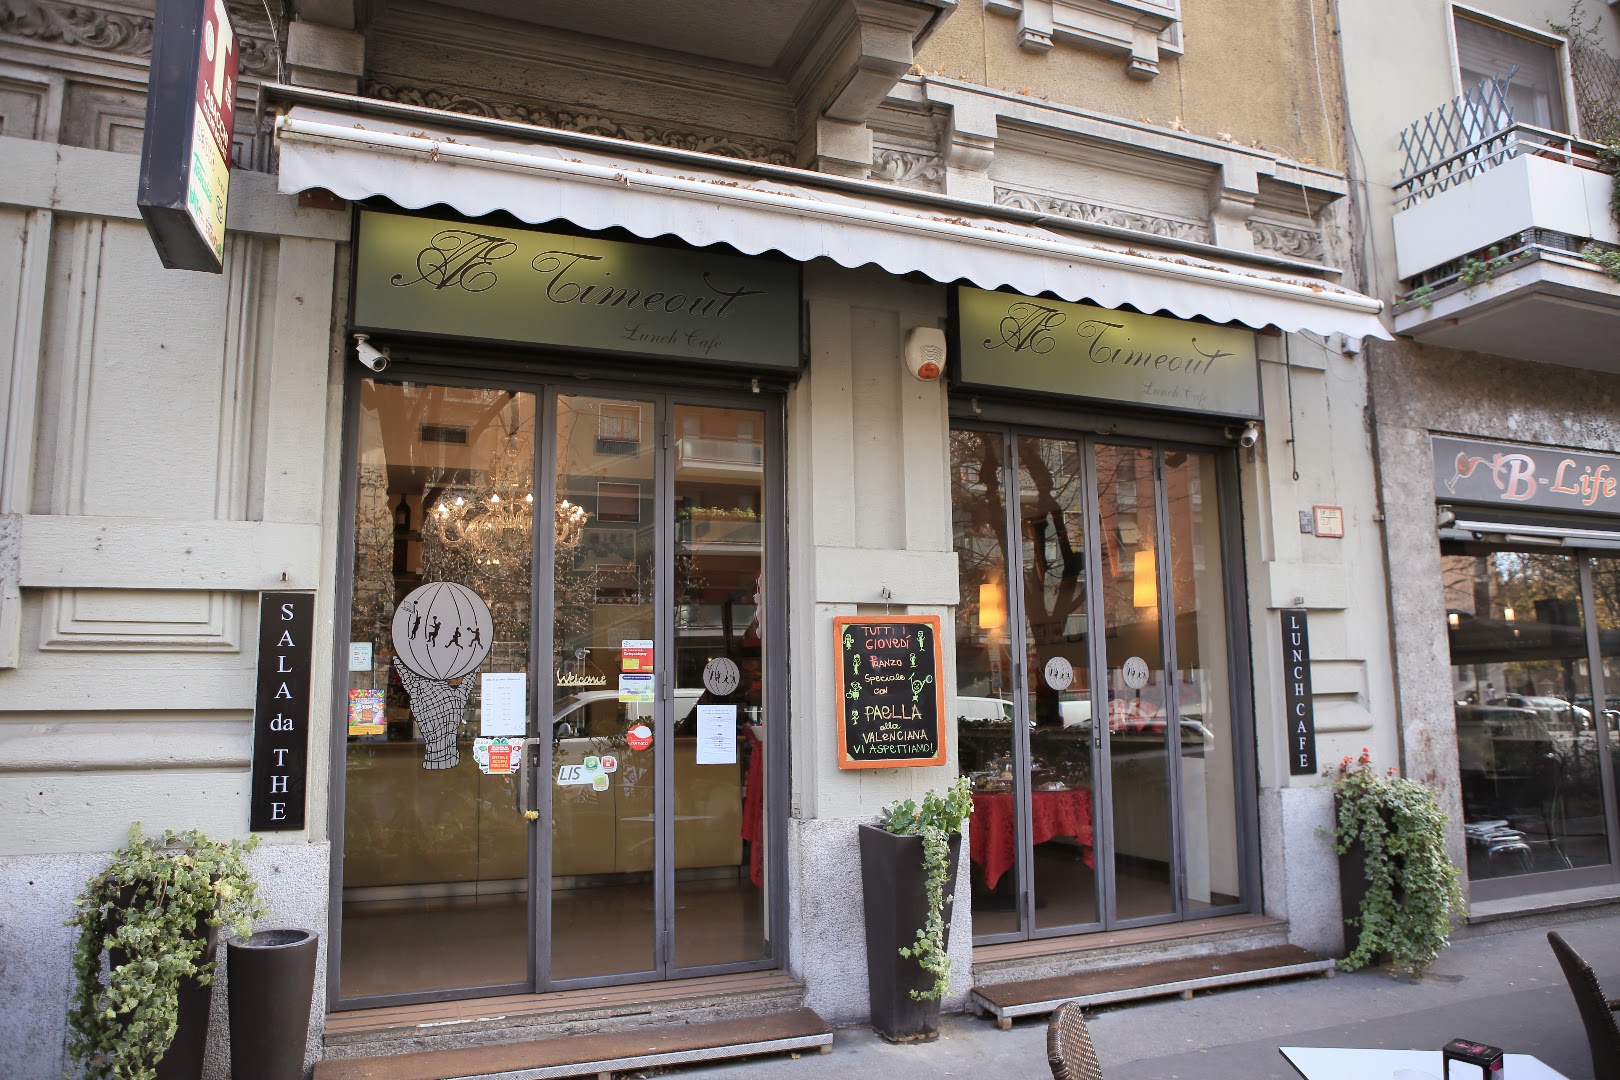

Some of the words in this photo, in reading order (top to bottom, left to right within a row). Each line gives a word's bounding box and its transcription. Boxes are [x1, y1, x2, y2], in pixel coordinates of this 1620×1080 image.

[204, 80, 229, 149] TABACCHI
[531, 250, 768, 320] Timeout
[621, 320, 679, 345] Lunch
[1076, 319, 1236, 376] Timeout
[1142, 381, 1180, 399] Lunch
[1493, 453, 1617, 506] B-Life
[861, 626, 895, 637] TUTTI
[274, 603, 296, 699] SALA
[1291, 616, 1305, 696] LUNCH
[556, 669, 607, 685] Welcome
[864, 674, 906, 685] Speciale
[270, 713, 295, 732] da
[879, 722, 901, 731] alla
[1296, 702, 1309, 768] CAFE
[852, 745, 865, 754] VI
[269, 748, 290, 821] THE
[559, 766, 581, 781] LIS
